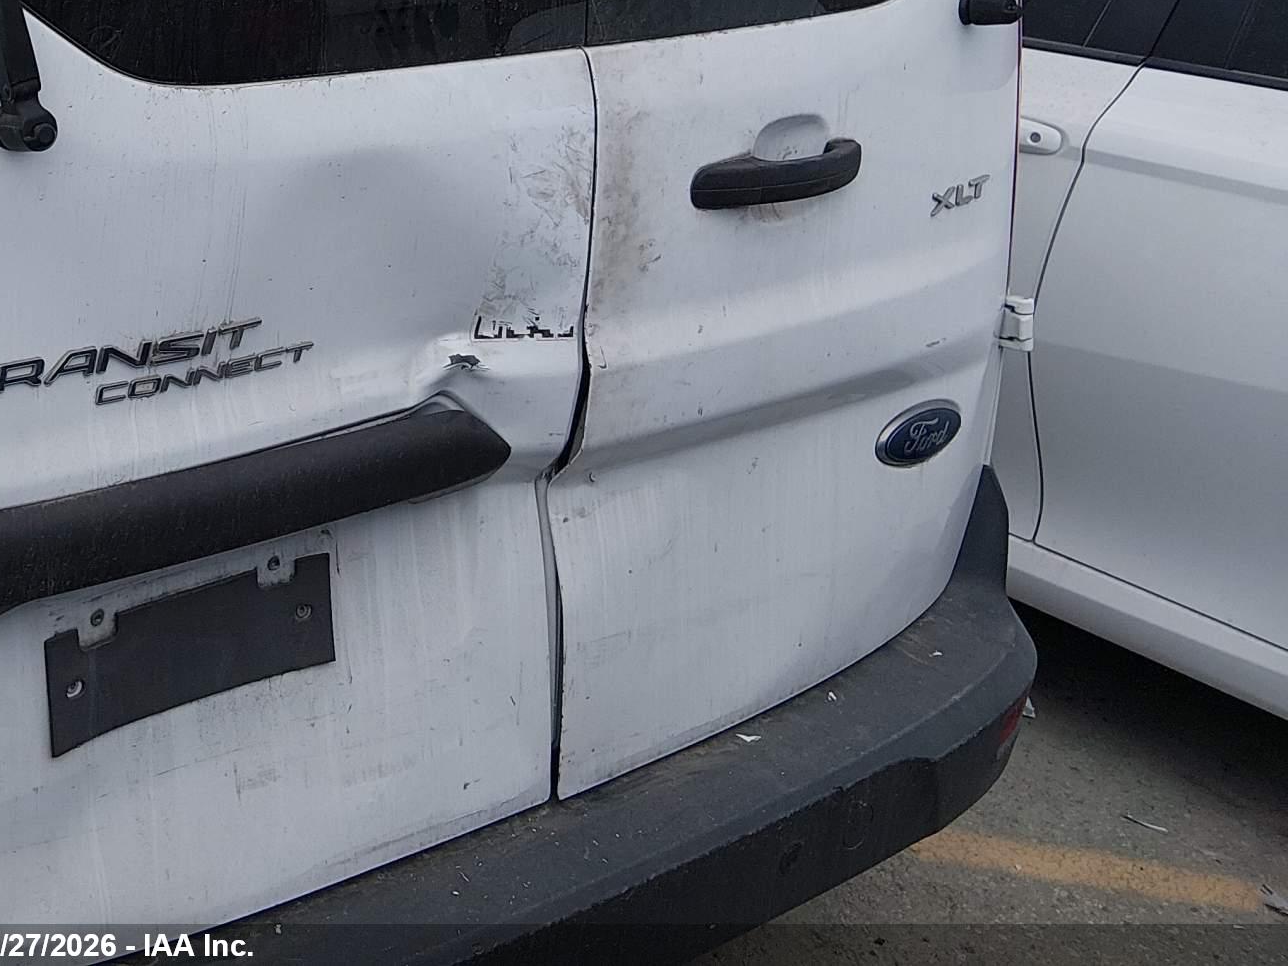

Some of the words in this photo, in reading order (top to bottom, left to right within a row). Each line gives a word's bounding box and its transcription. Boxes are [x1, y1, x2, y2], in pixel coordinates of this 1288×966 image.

[930, 174, 990, 217] XLT
[95, 341, 314, 406] CONNECT
[903, 417, 950, 453] Ford
